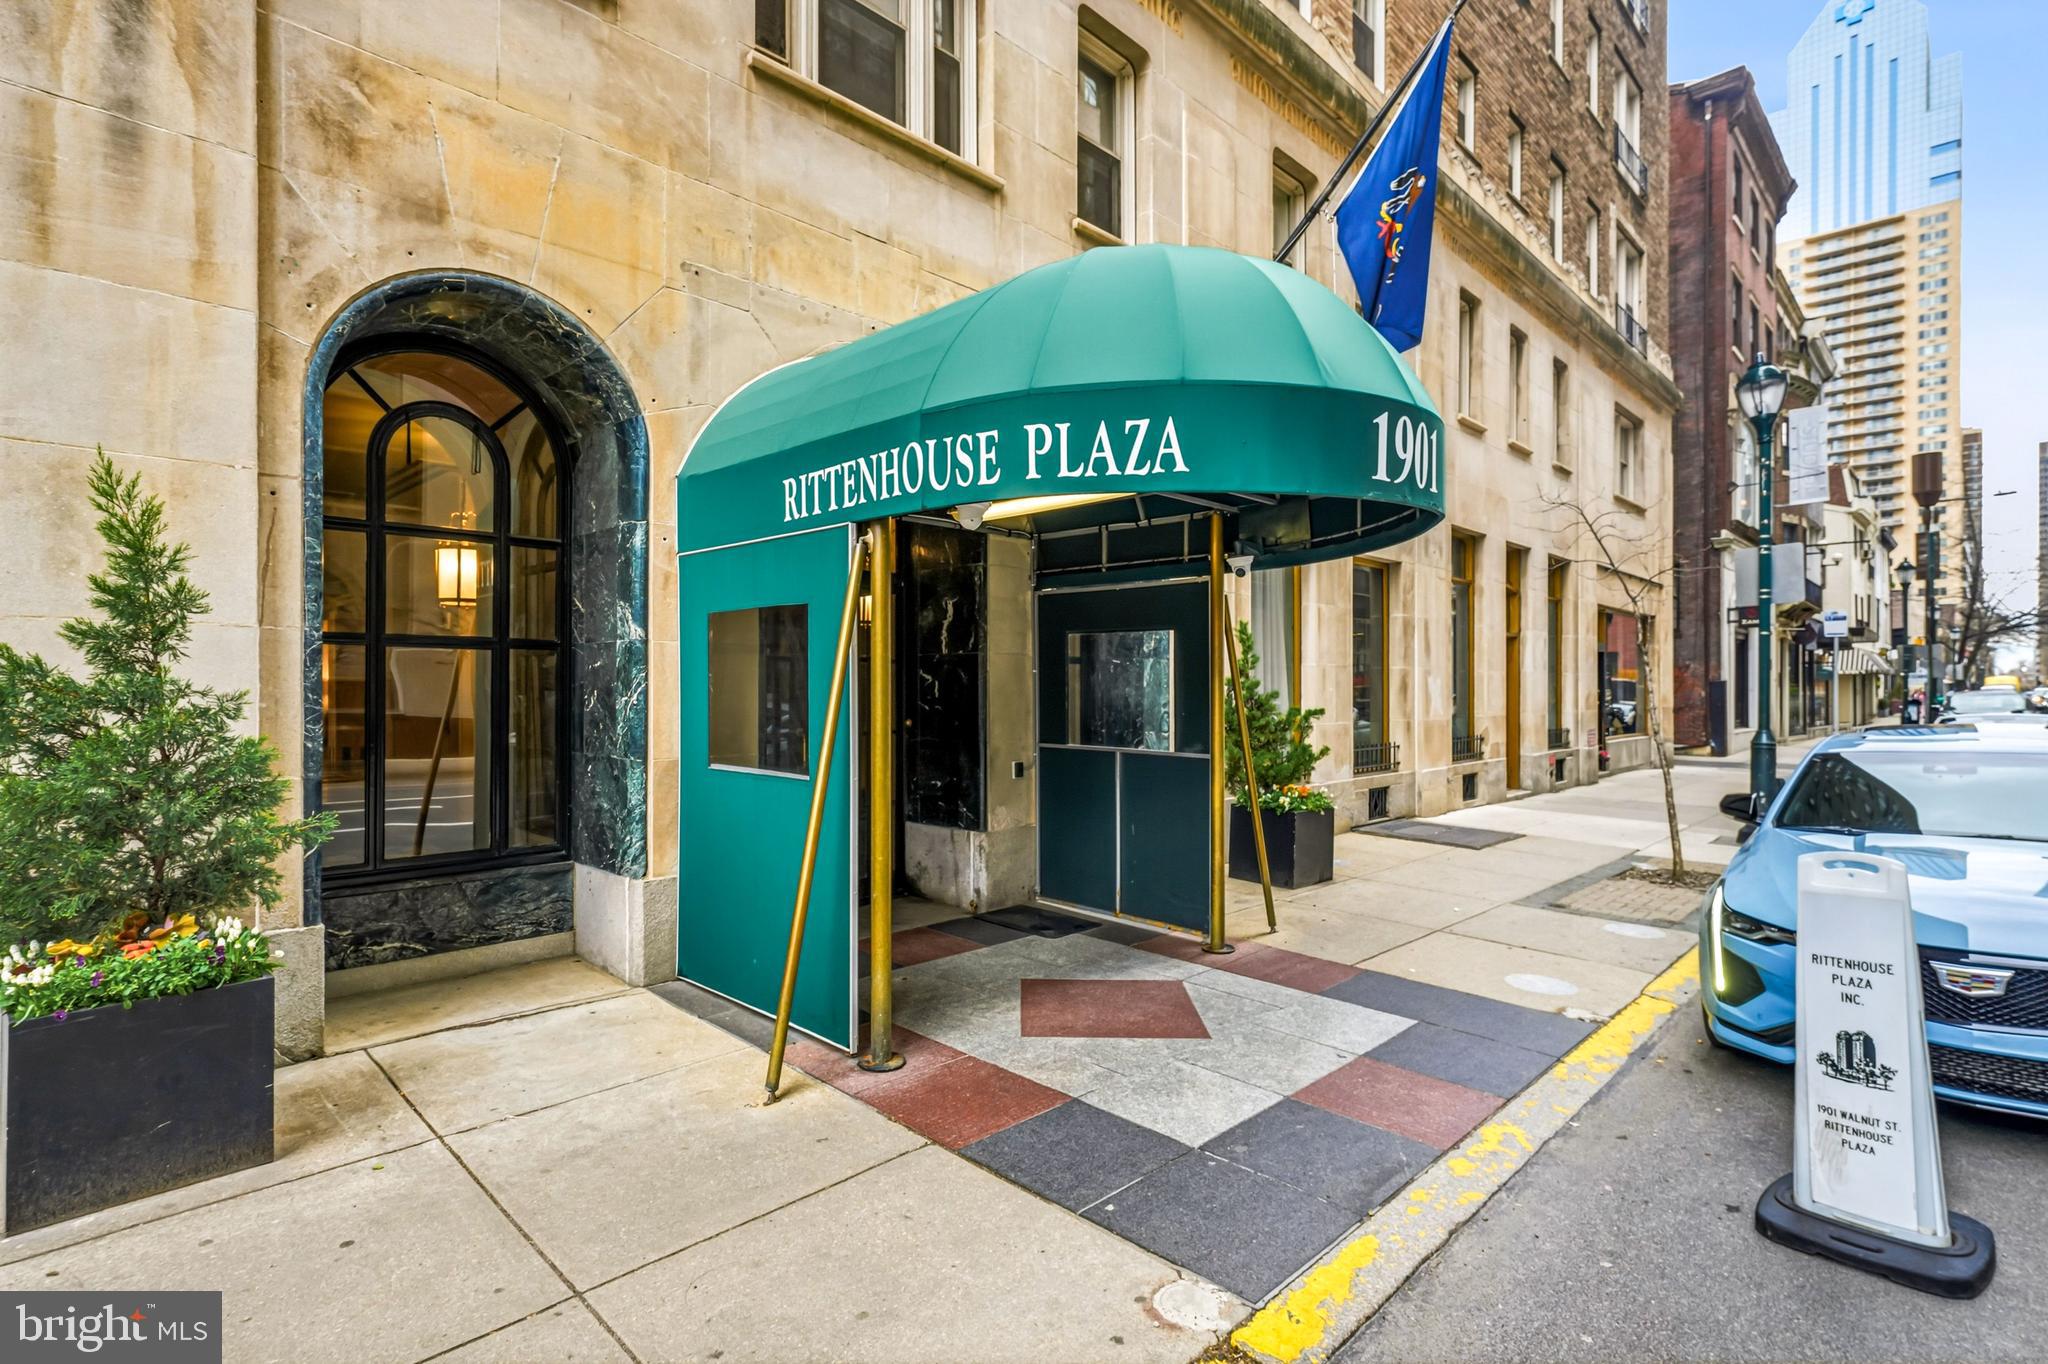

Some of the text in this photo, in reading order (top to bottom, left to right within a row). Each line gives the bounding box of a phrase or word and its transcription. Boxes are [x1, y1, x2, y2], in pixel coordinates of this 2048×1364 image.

[1371, 411, 1438, 494] 1901
[782, 416, 1190, 523] RITTENHOUSE PLAZA
[1811, 953, 1895, 976] RITTENHOUSE
[1832, 973, 1873, 990] PLAZA
[1840, 991, 1865, 1007] INC.
[1817, 1104, 1902, 1132] 1901 WALNUT ST.
[1824, 1119, 1894, 1145] RITTENHOUSE
[1841, 1138, 1876, 1156] PLAZA
